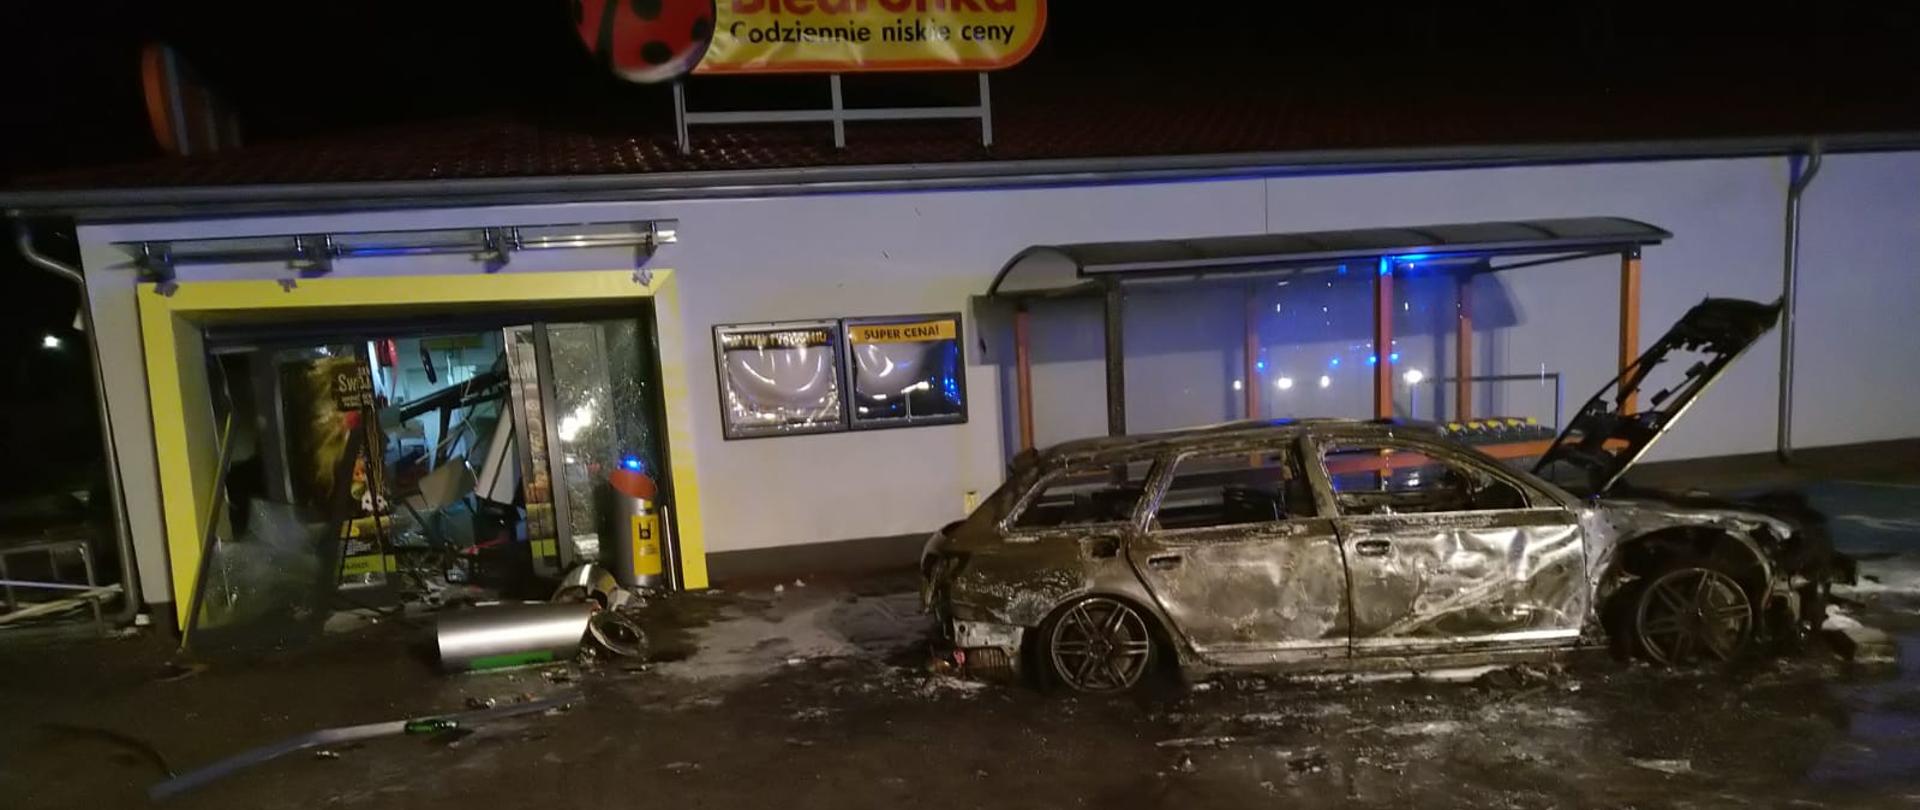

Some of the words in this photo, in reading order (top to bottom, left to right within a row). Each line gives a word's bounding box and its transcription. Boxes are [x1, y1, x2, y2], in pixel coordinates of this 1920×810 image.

[730, 20, 871, 43] Codziennie
[961, 24, 1015, 44] ceny
[864, 327, 900, 340] SUPER
[904, 325, 939, 338] CENA!
